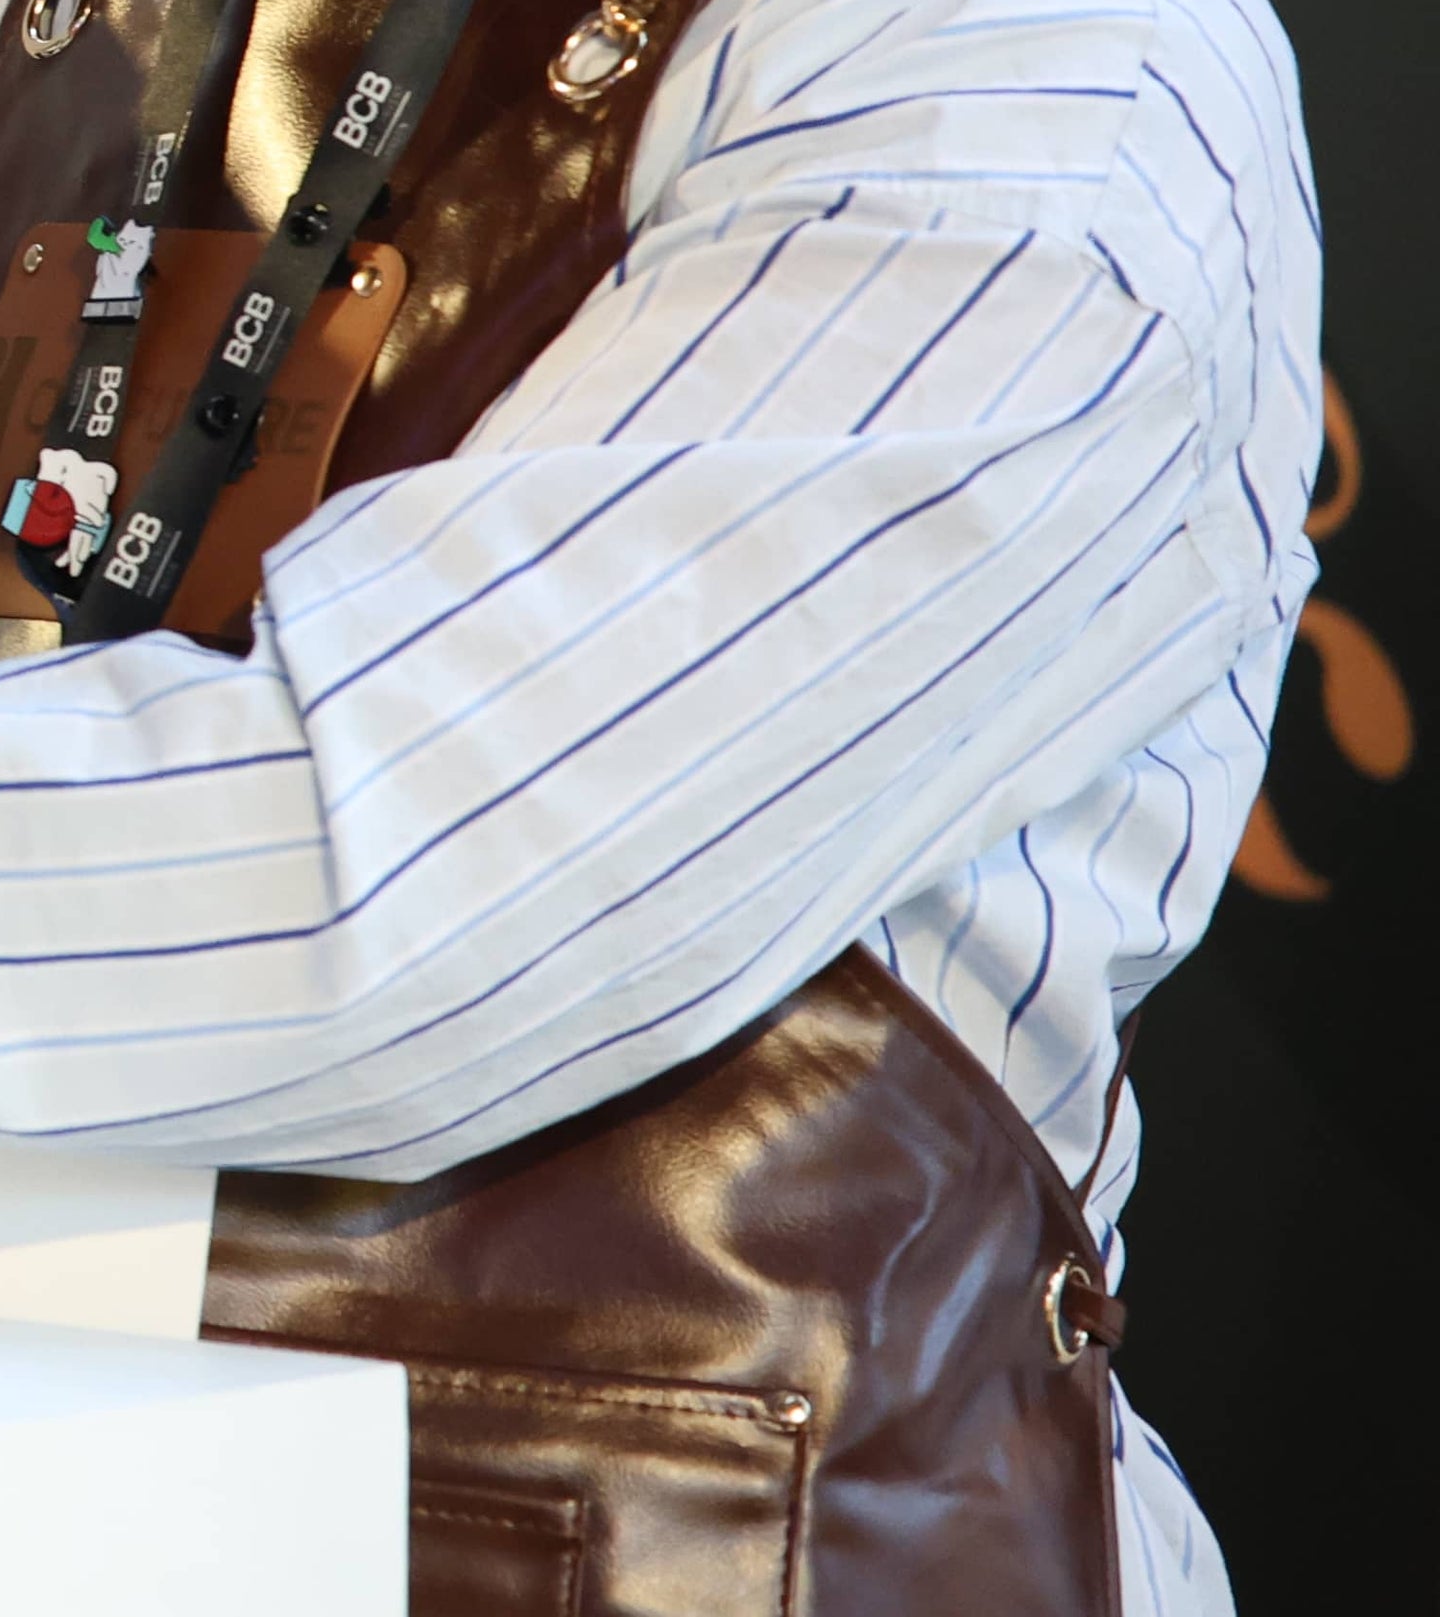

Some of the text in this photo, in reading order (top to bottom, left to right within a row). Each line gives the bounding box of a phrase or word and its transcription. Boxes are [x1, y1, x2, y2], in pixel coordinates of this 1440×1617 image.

[332, 71, 391, 148] BCB
[144, 132, 176, 204] BCB
[222, 292, 274, 368] BCB
[86, 366, 123, 437] BCB
[104, 512, 162, 589] BCB
